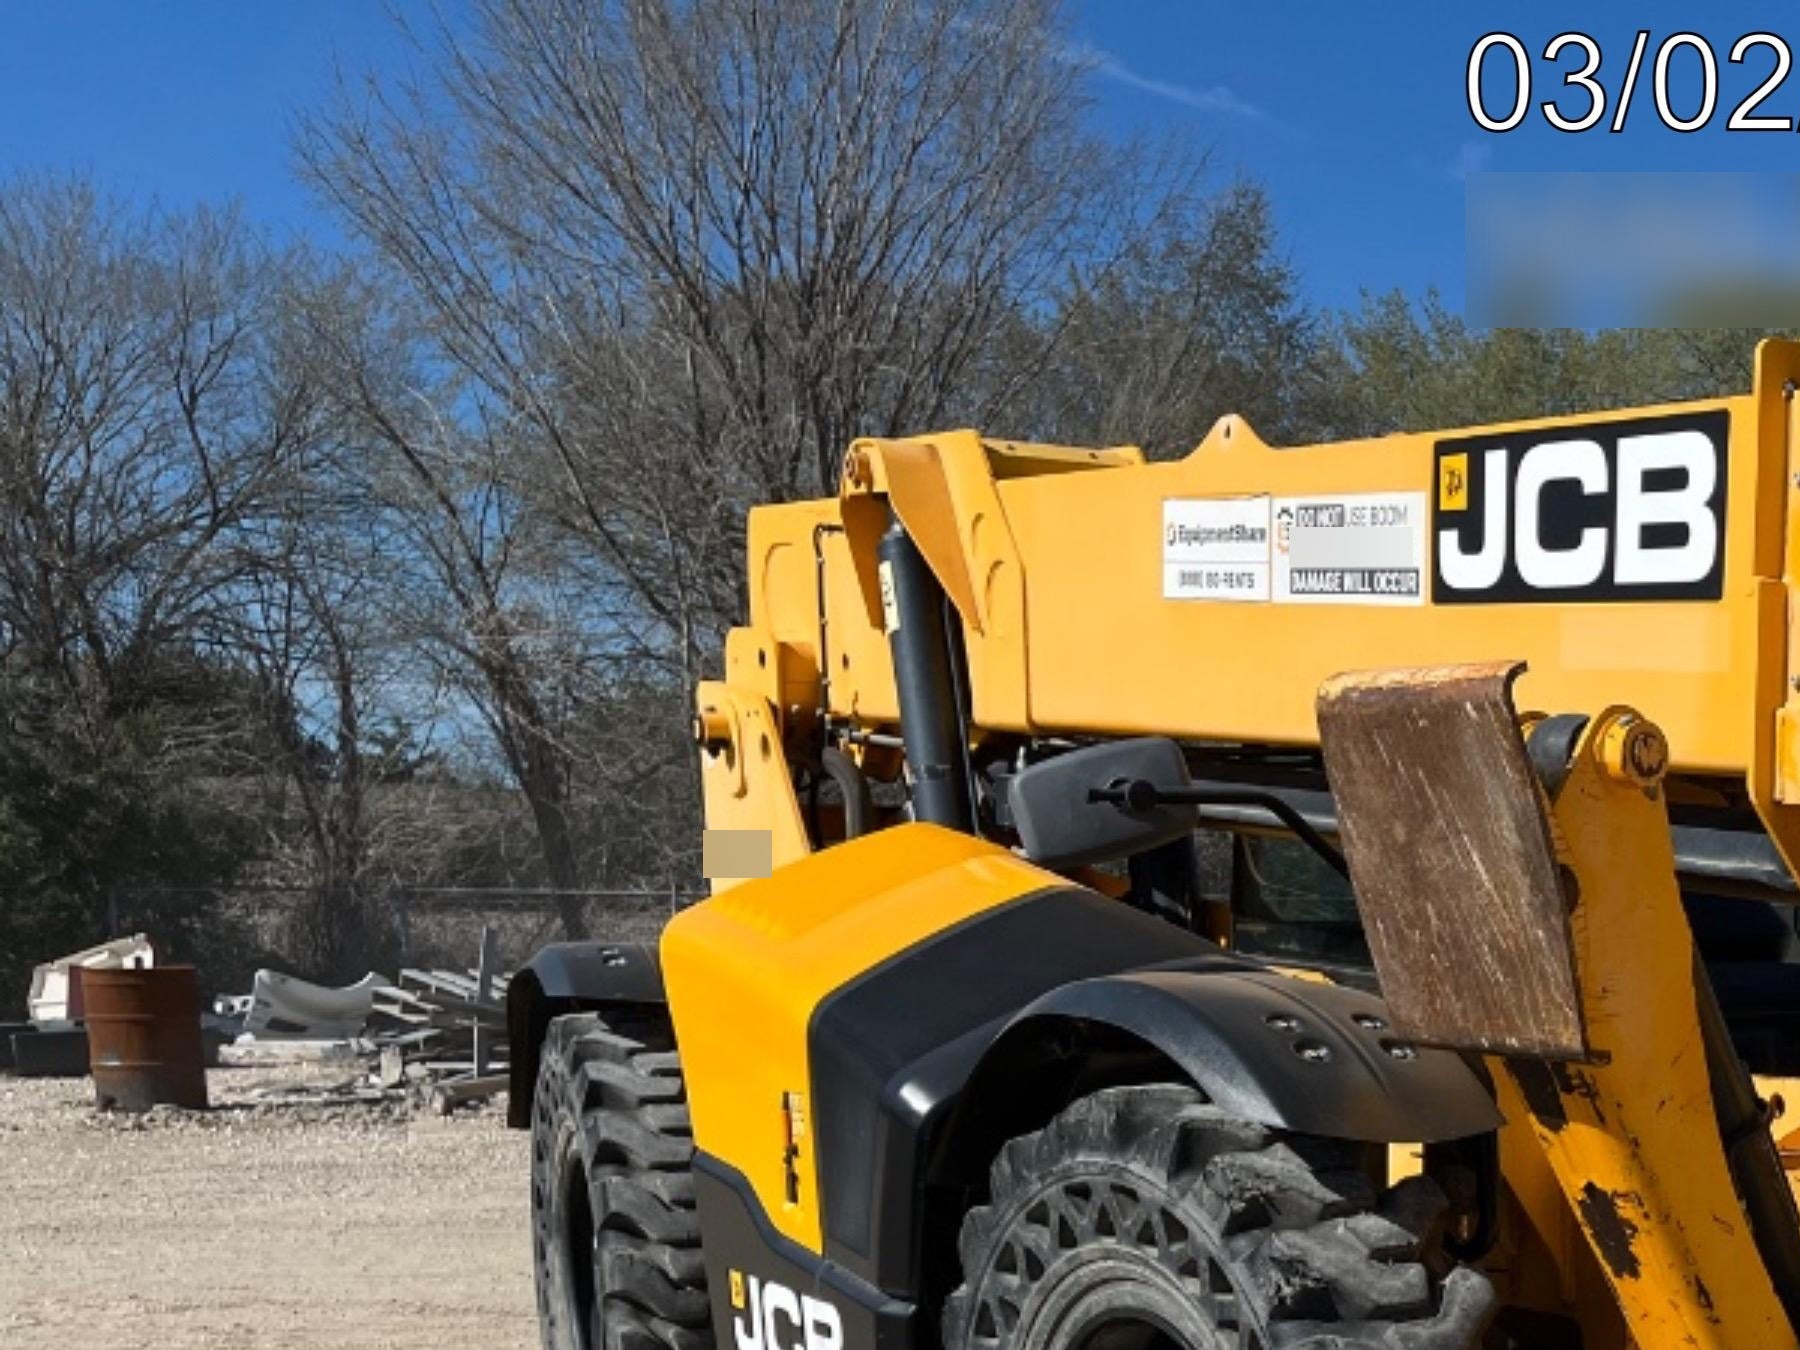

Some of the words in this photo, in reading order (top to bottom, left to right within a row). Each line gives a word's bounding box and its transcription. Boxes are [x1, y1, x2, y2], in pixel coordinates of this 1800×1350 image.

[1439, 431, 1717, 589] JCB
[1178, 524, 1267, 546] EquipmentShare
[1292, 570, 1341, 592] DAMAGE
[1343, 571, 1371, 592] WILL
[1373, 571, 1417, 593] OCCUR
